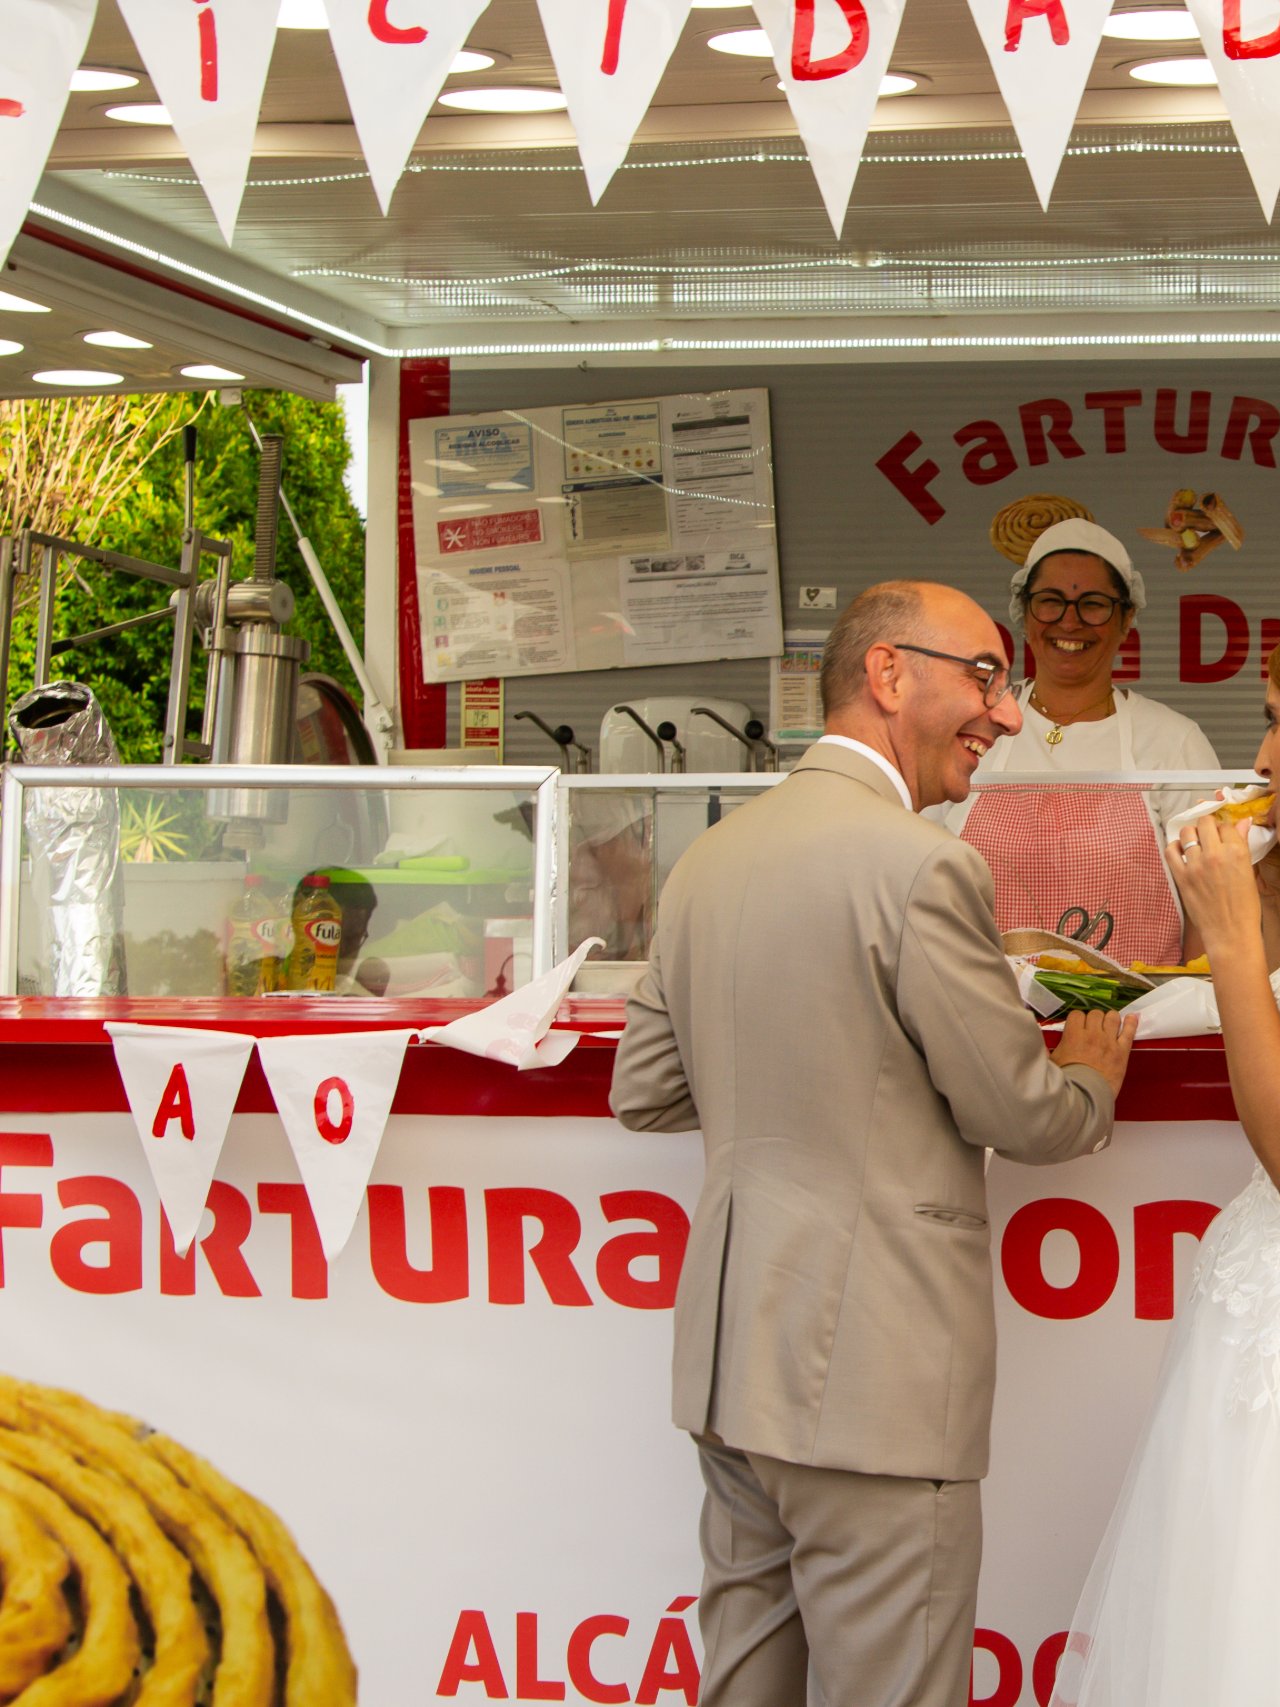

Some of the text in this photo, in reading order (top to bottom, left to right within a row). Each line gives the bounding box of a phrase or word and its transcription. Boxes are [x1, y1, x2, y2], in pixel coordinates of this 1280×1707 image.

[468, 428, 500, 438] AVISO
[0, 1132, 691, 1310] FaRTURa
[436, 1595, 701, 1706] ALCÁ
